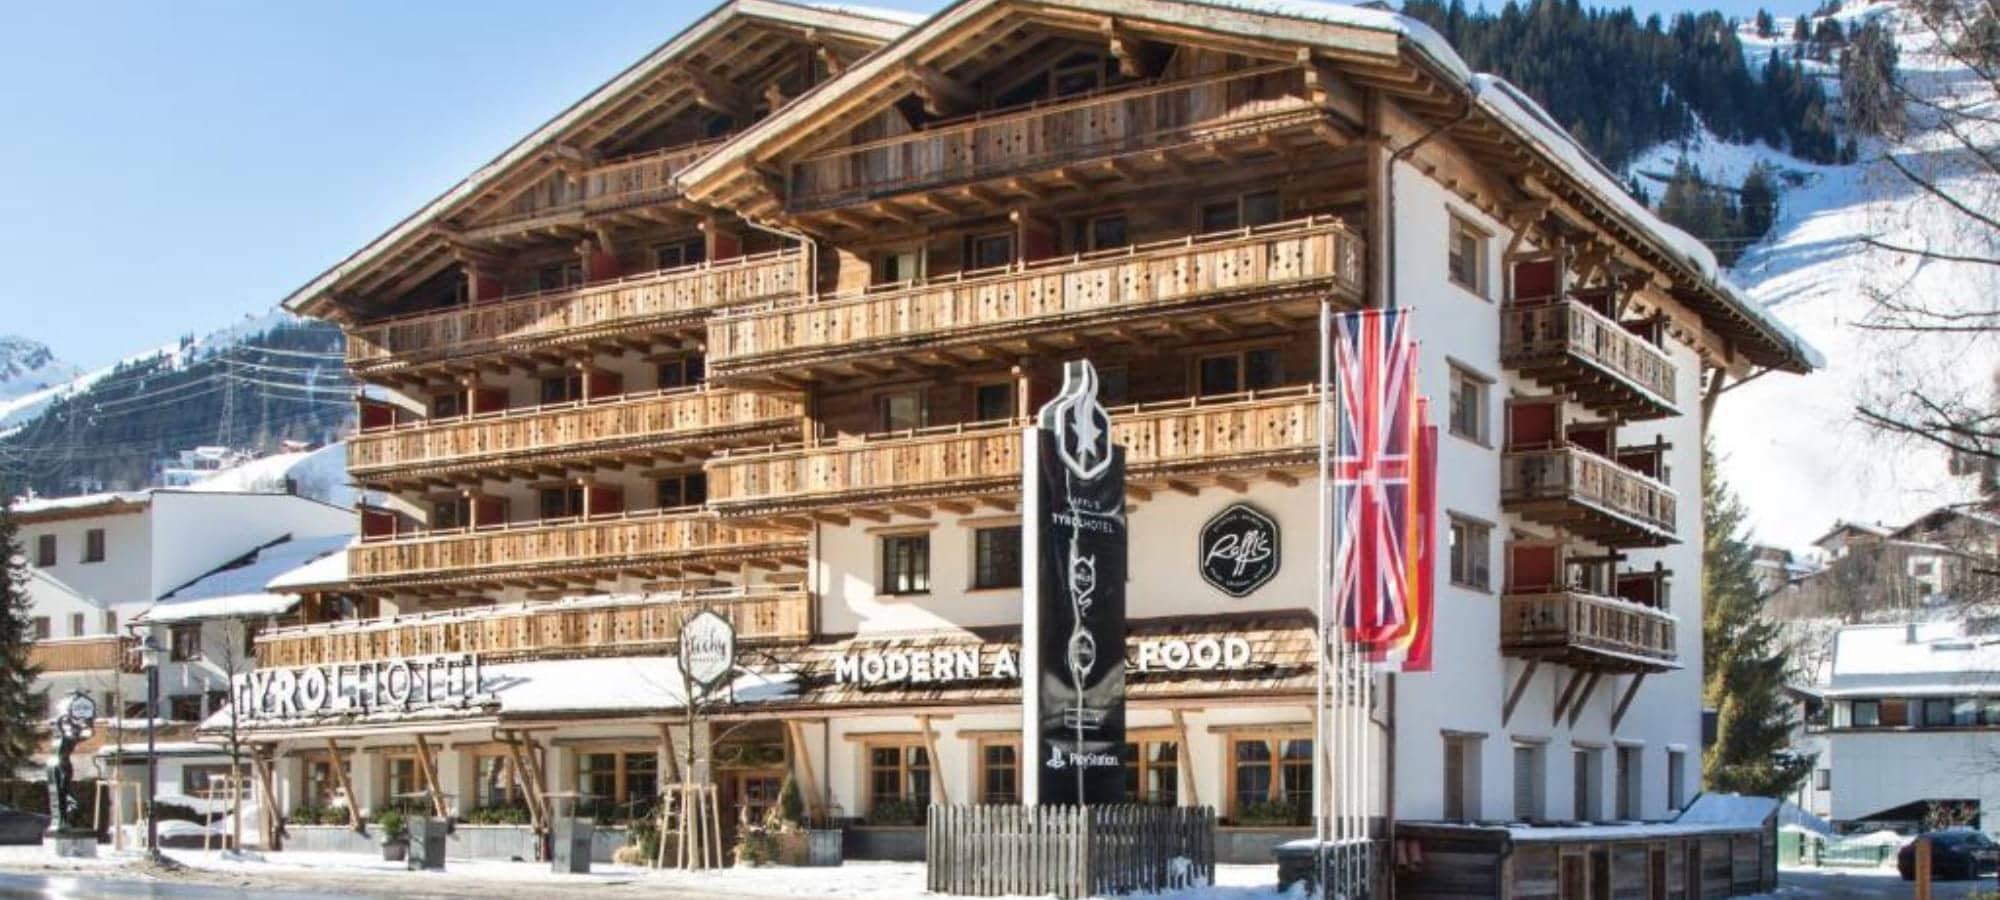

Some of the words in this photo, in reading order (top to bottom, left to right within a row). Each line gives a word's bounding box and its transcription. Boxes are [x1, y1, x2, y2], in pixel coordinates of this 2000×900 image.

[832, 645, 981, 683] MODERN
[991, 647, 1024, 678] A
[1138, 637, 1250, 672] FOOD
[231, 653, 494, 719] TYROLHOTEL
[1069, 752, 1119, 769] PlayStation
